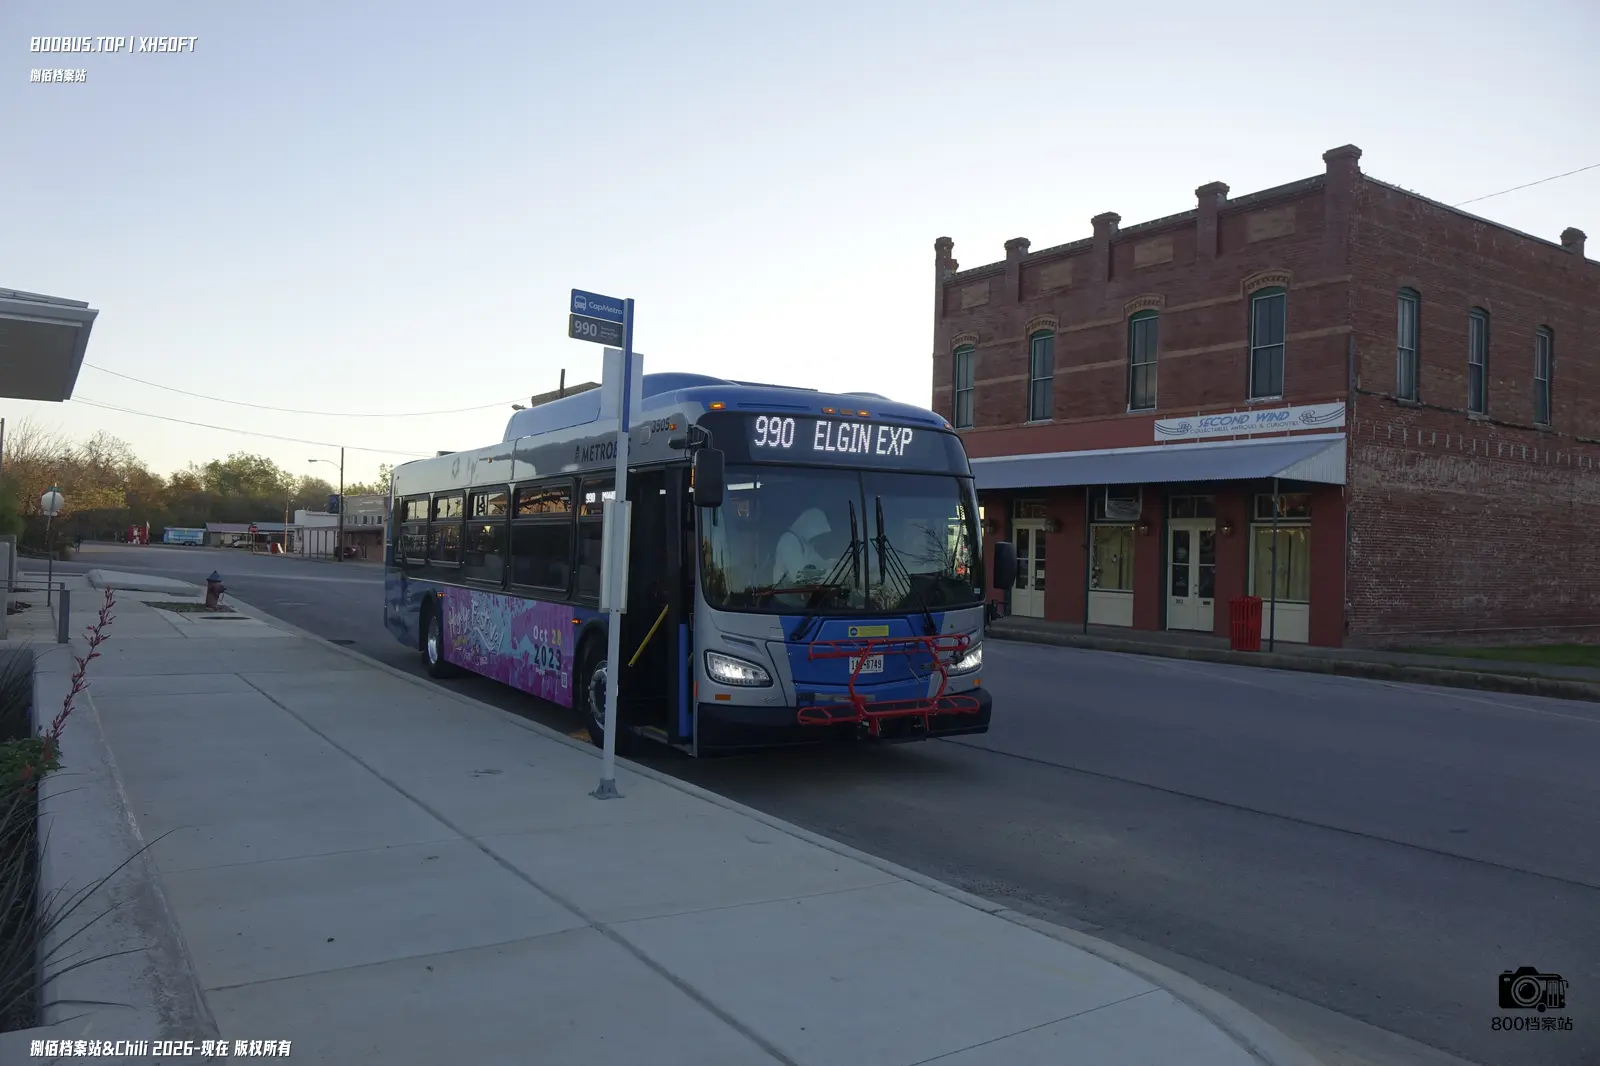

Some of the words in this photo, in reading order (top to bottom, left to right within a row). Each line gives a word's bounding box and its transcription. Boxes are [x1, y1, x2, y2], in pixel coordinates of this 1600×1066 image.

[588, 301, 623, 315] CapMetro
[575, 320, 597, 337] 990
[651, 417, 670, 433] 3505
[1198, 414, 1250, 428] SECOND
[1256, 411, 1290, 422] WIND
[754, 415, 796, 448] 990
[813, 420, 872, 454] ELGIN
[876, 425, 913, 456] EXP
[533, 624, 548, 643] Oct
[534, 644, 562, 671] 2023
